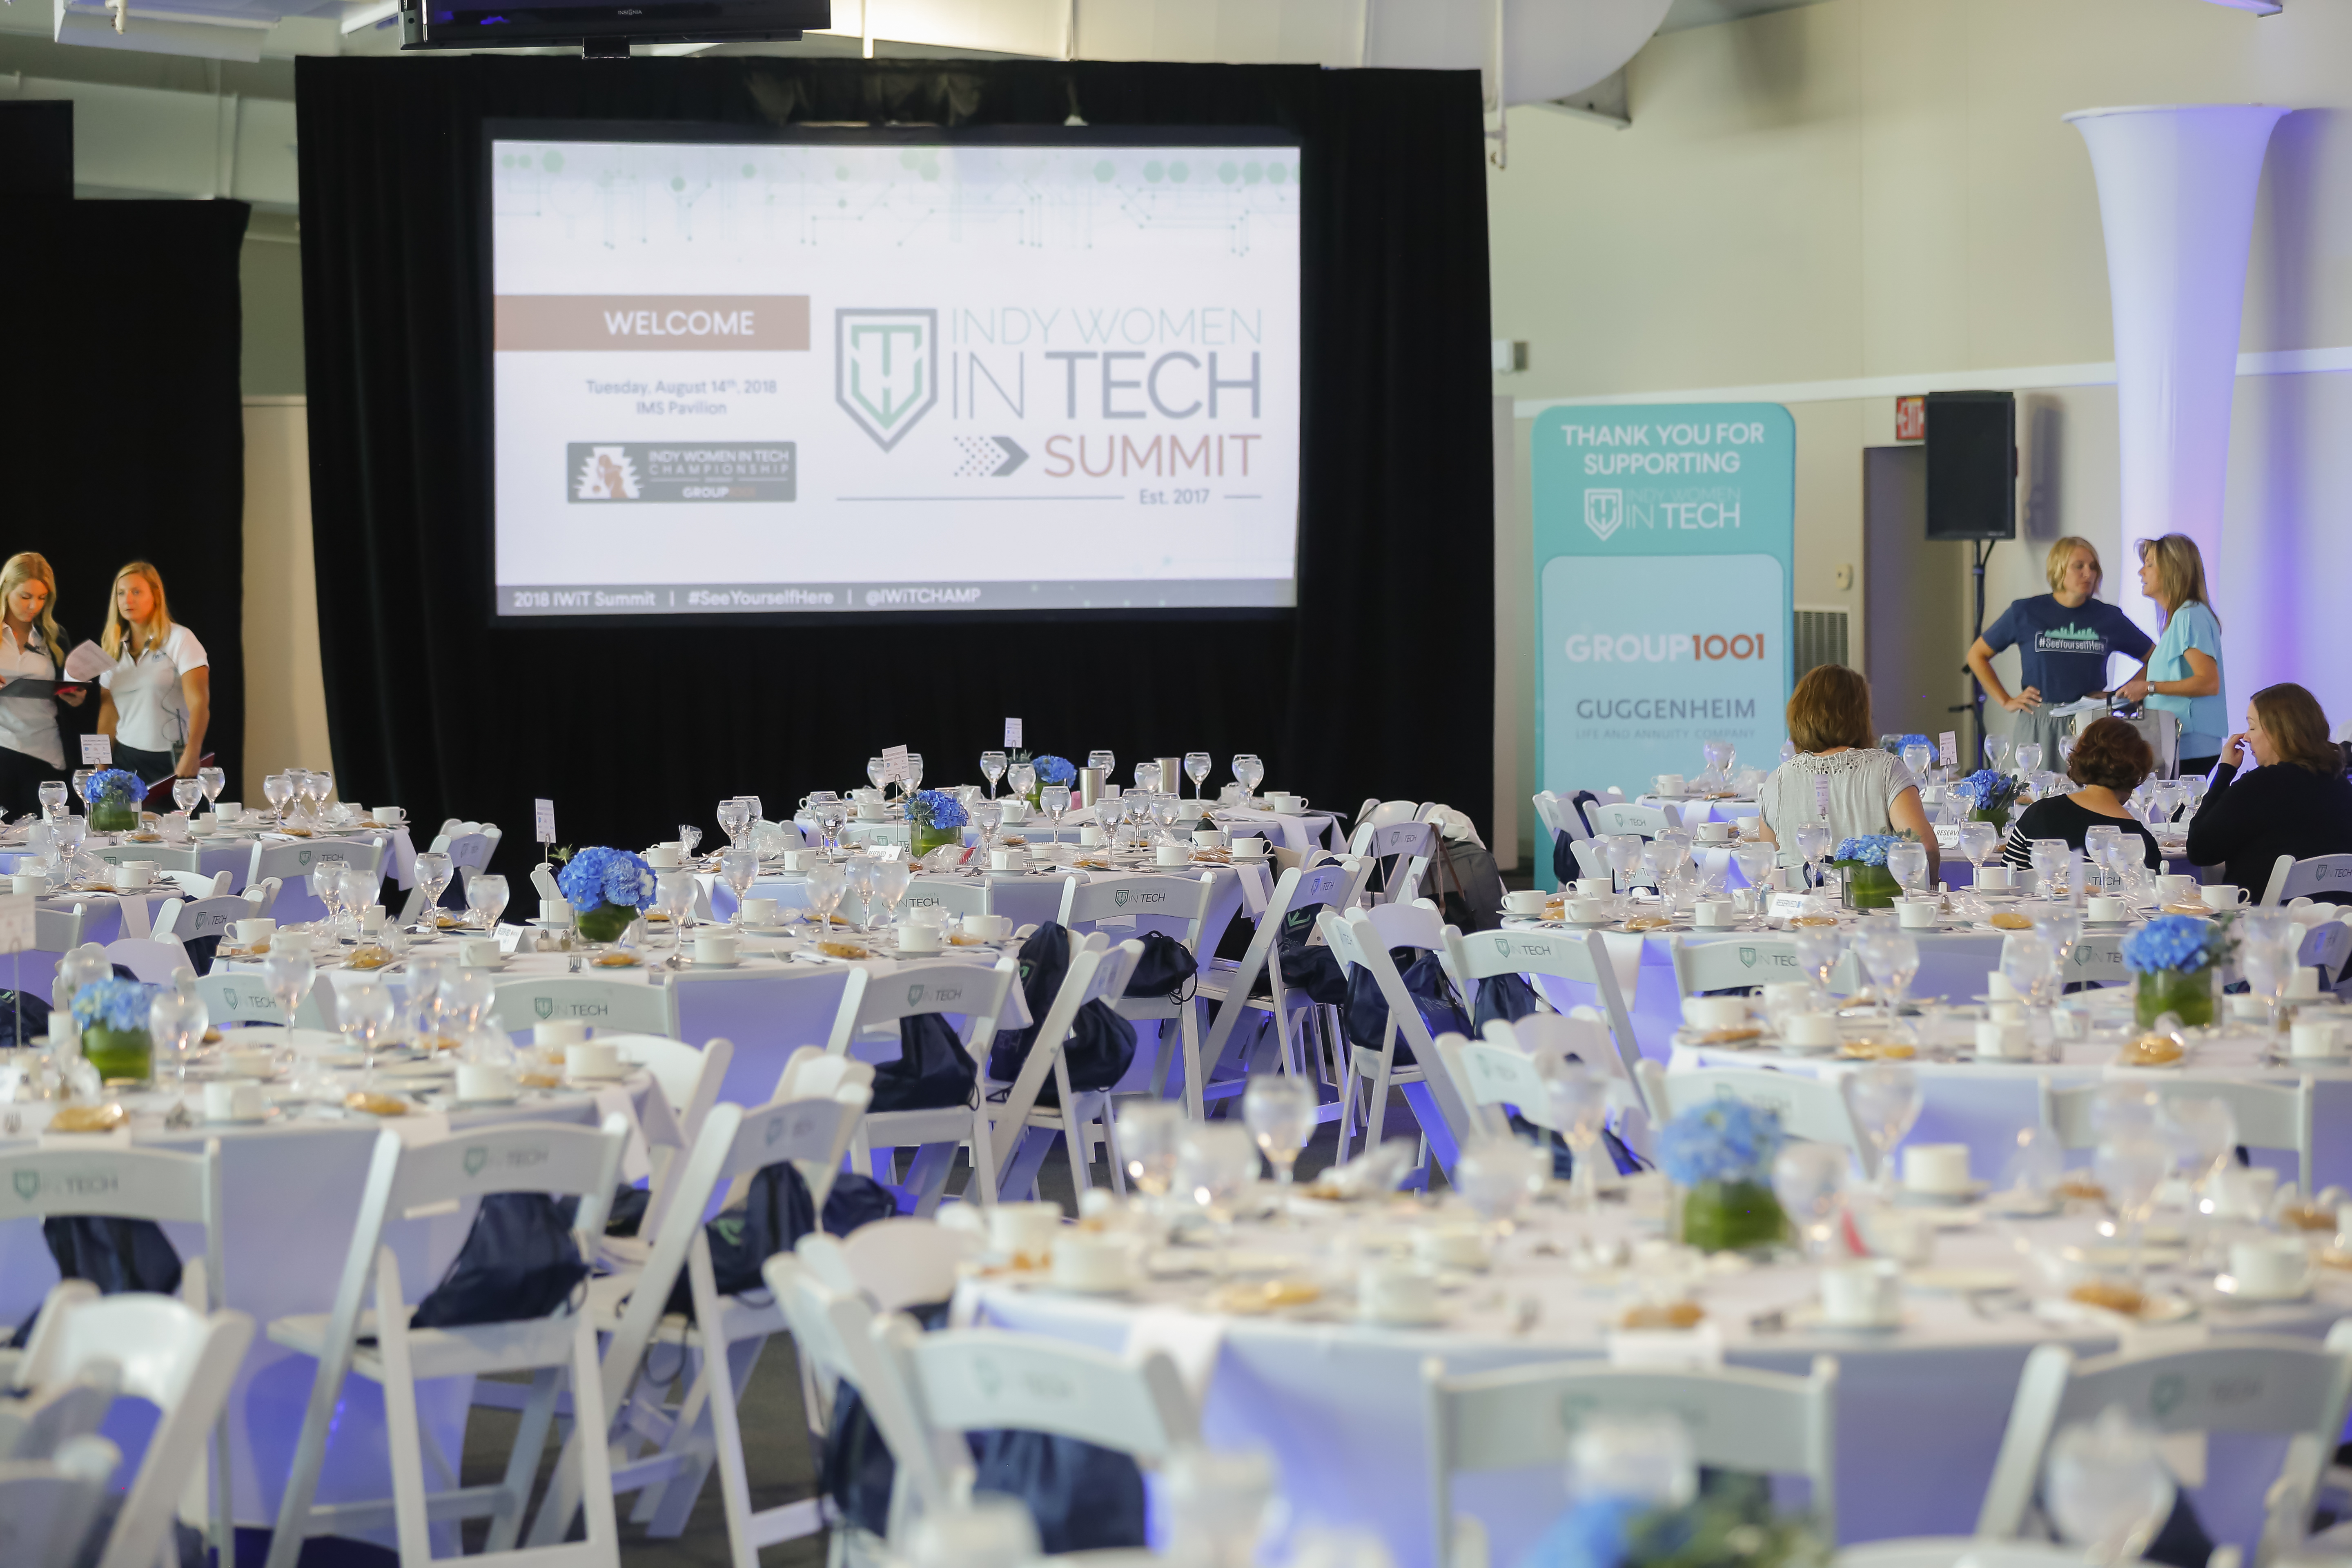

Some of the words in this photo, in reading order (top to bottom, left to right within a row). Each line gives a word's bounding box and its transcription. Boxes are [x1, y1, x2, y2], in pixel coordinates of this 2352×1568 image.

[604, 310, 755, 336] WELCOME
[952, 307, 1060, 345] INDY
[1071, 307, 1262, 345] WOMEN
[586, 380, 651, 397] Tuesday,
[655, 380, 707, 397] August
[744, 380, 777, 394] 2018
[952, 351, 1025, 420] IN
[1045, 351, 1261, 420] TECH
[636, 401, 665, 415] IMS
[669, 401, 727, 415] Pavilion
[1561, 425, 1649, 446] THANK
[1656, 424, 1711, 446] YOU
[1716, 422, 1764, 444] FOR
[648, 450, 682, 463] INDY
[684, 450, 737, 463] WOMEN
[737, 450, 752, 463] IN
[753, 450, 789, 463] TECH
[1044, 433, 1262, 478] SUMMIT
[648, 463, 790, 476] CHAMPIONSHIP
[1584, 452, 1741, 474] SUPPORTING
[1139, 488, 1168, 505] Est.
[1173, 488, 1210, 505] 2017
[1626, 489, 1666, 501] INDY
[1669, 488, 1741, 502] WOMEN
[1626, 505, 1654, 529] IN
[1661, 503, 1740, 529] TECH
[514, 591, 550, 607] 2018
[594, 590, 656, 607] Summit
[688, 588, 835, 606] #SeeYourselfHere
[1565, 633, 1764, 662] GROUP1001
[2039, 637, 2105, 652] #SeeYourselfHere
[1577, 699, 1755, 719] GUGGENHEIM
[1577, 730, 1599, 740] LIFE
[1603, 730, 1629, 740] AND
[1634, 729, 1690, 740] ANNUITY
[1696, 728, 1755, 739] COMPANY
[321, 853, 344, 862] TECH
[2335, 869, 2352, 878] TECH
[1323, 880, 1335, 891] TECH
[909, 898, 939, 907] TECH
[1128, 894, 1139, 903] IN
[1140, 893, 1165, 903] TECH
[212, 914, 228, 925] TECH
[1521, 945, 1551, 956] TECH
[1771, 954, 1797, 966] TEC
[248, 996, 277, 1008] TECH
[936, 989, 962, 1001] TECH
[570, 1004, 608, 1016] TECH
